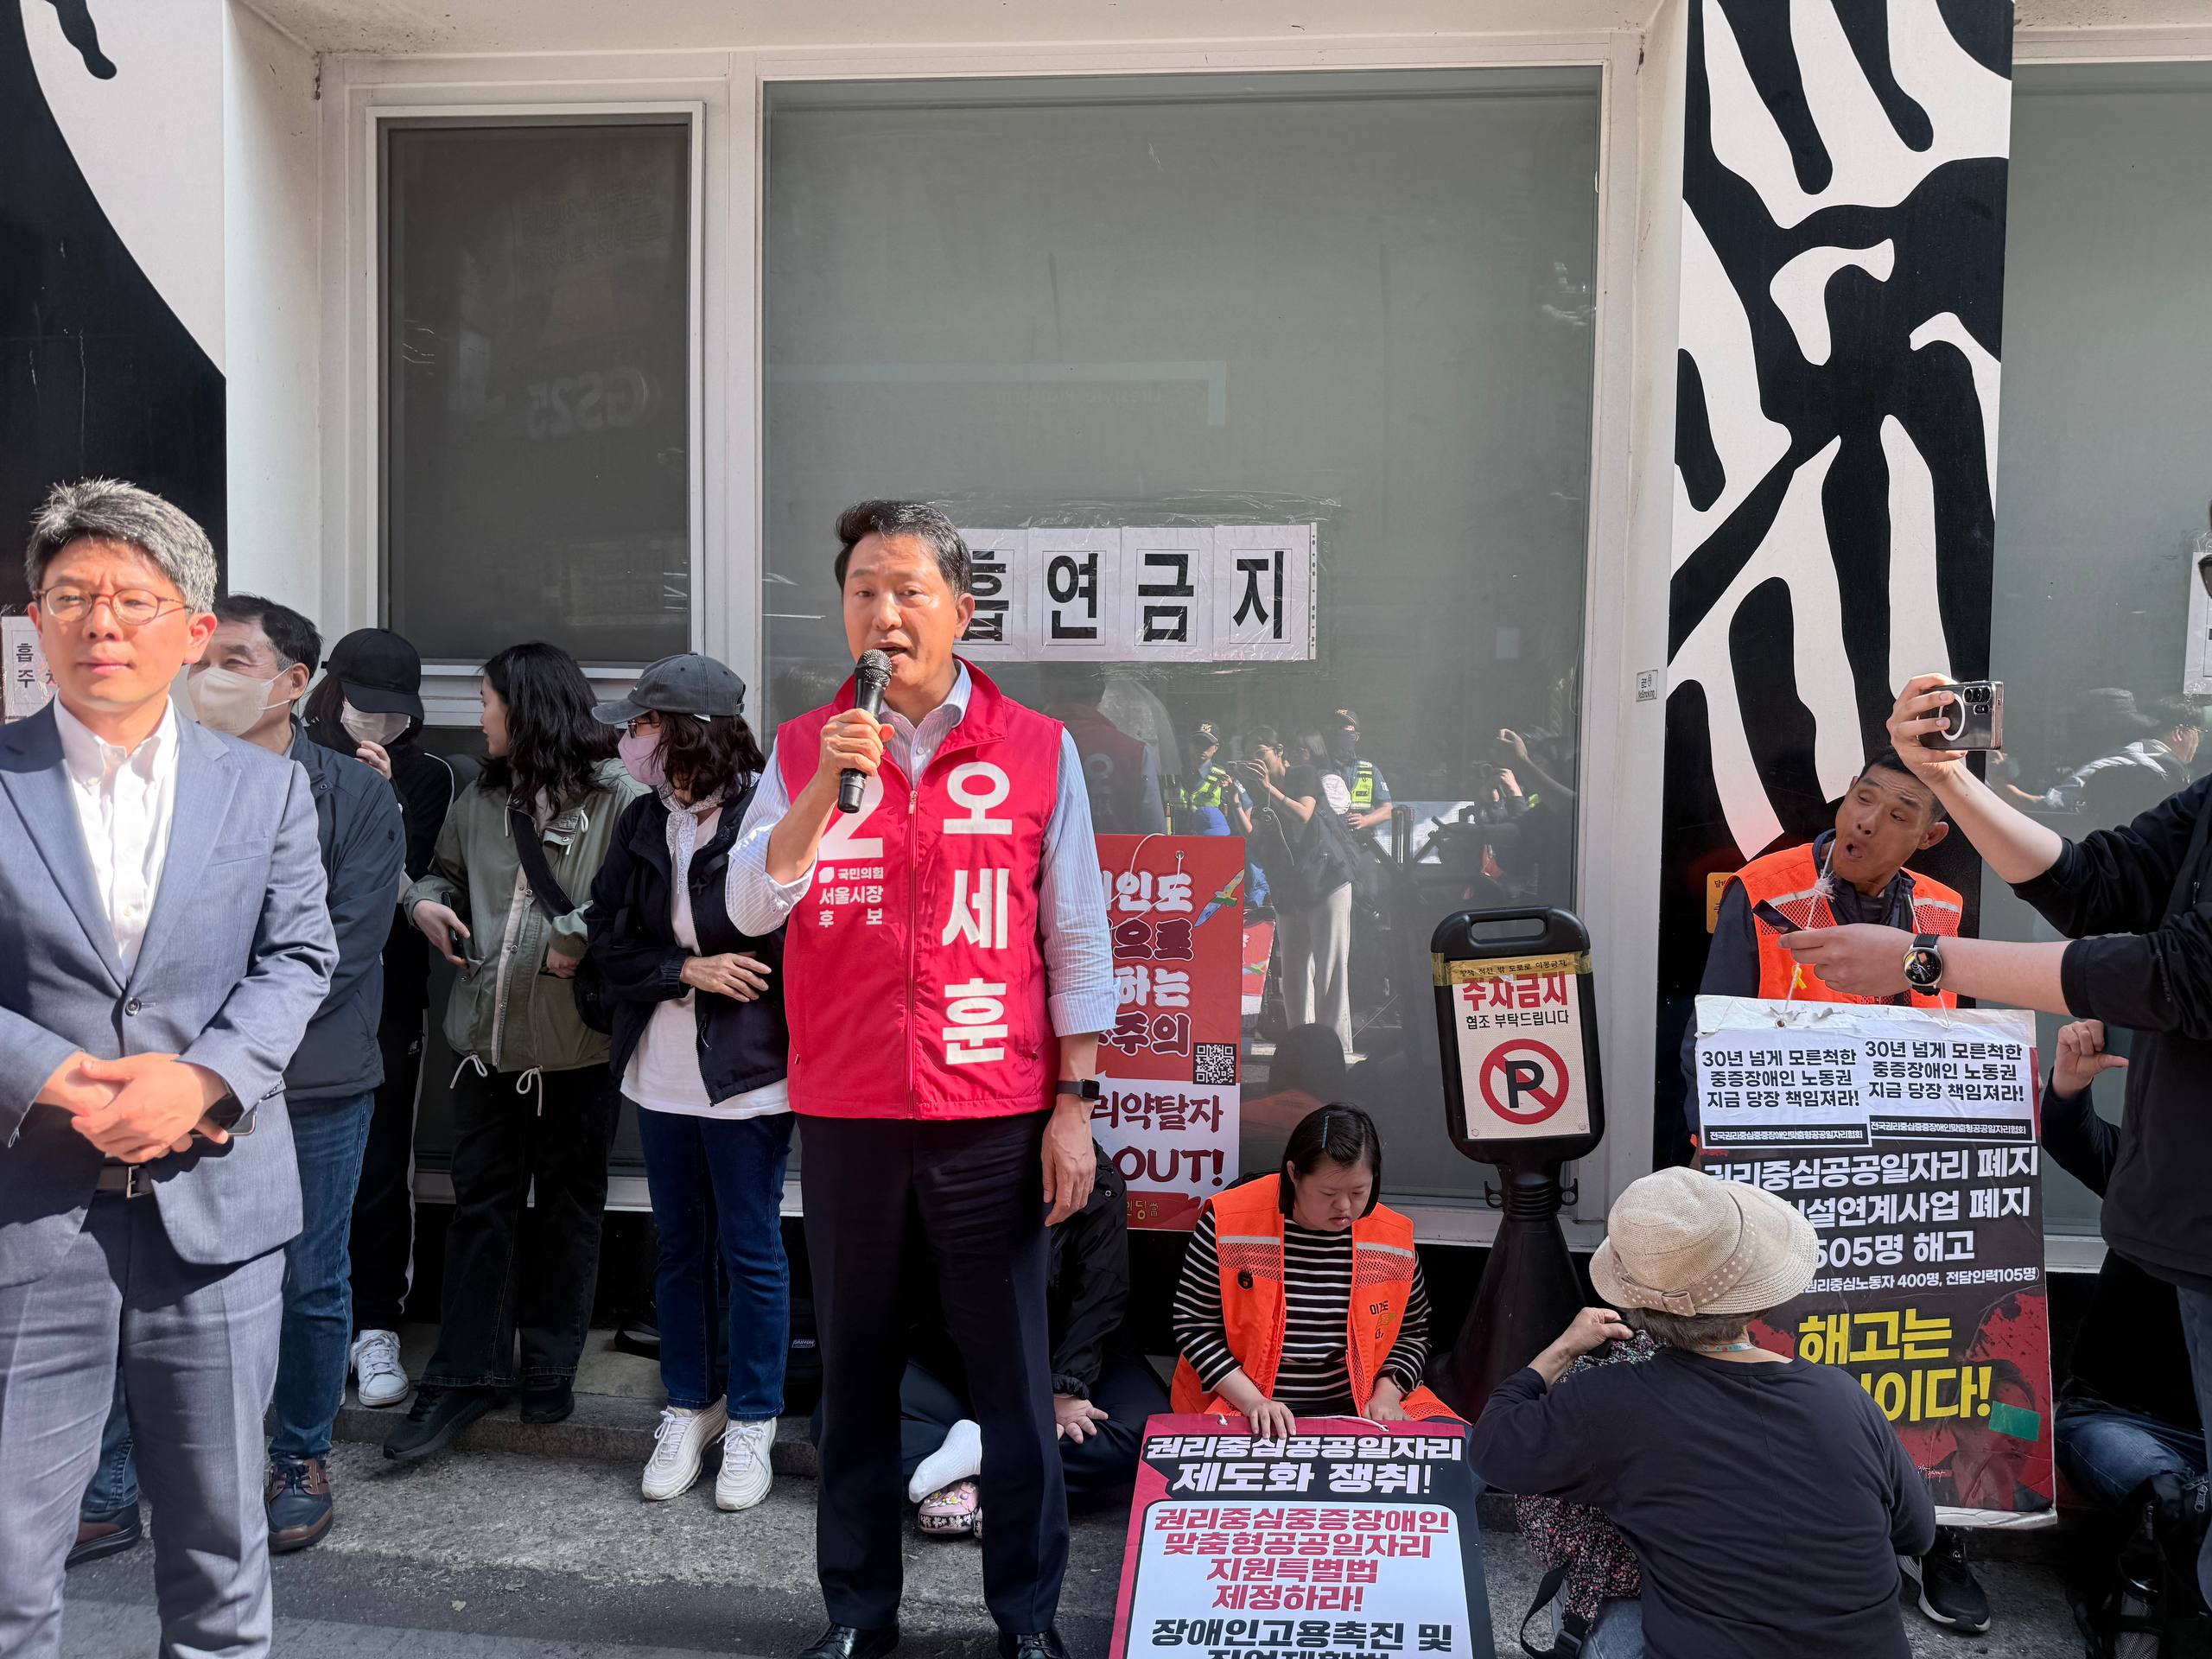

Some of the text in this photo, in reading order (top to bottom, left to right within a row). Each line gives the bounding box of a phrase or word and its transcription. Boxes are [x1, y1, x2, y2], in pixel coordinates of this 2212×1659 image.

[837, 867, 884, 880] 국민의힘
[818, 885, 884, 906] 서울시장
[1465, 1009, 1569, 1030] 협조 부탁드립니다
[1701, 1049, 1857, 1067] 30년 넘게 모른척한
[1865, 1041, 2022, 1060] 30년 넘게 모른척한
[1710, 1070, 1852, 1087] 중증장애인 노동권
[1872, 1061, 2017, 1081] 중증장애인 노동권
[1707, 1090, 1859, 1108] 지금 당장 책임져라!
[1868, 1082, 2024, 1102] 지금 당장 책임져라!
[1111, 1146, 1224, 1187] OUT!
[1977, 1146, 2038, 1178] 폐지
[1969, 1186, 2030, 1218] 폐지
[1913, 1230, 1975, 1262] 해고
[1897, 1272, 1942, 1288] 400명,
[1799, 1308, 1953, 1364] 해고는
[1147, 1436, 1462, 1461] 권리중심공공일자리
[1172, 1461, 1432, 1494] 제도화 쟁취!
[1154, 1508, 1449, 1533] 권리중심중증장애인
[1164, 1532, 1431, 1559] 맞춤형공공일자리
[1206, 1557, 1378, 1584] 지원특별법
[1212, 1585, 1363, 1611] 제정하라!
[1152, 1618, 1452, 1652] 장애인고용촉진 및
